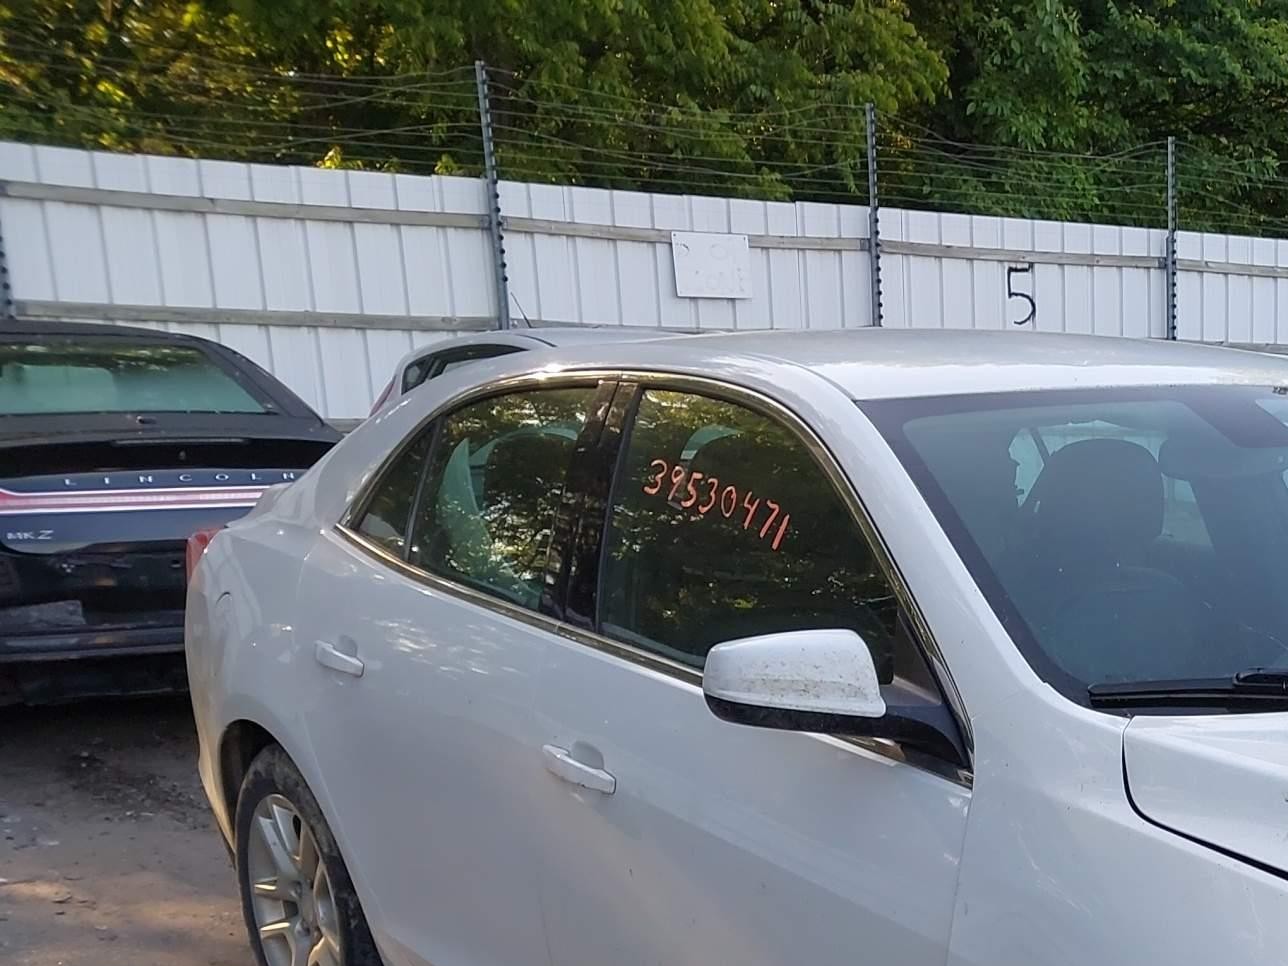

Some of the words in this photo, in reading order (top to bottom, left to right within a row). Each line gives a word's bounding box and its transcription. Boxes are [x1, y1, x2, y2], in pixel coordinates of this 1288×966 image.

[1007, 262, 1036, 325] 5
[65, 472, 295, 486] LINCOLN
[643, 458, 791, 551] 39530471
